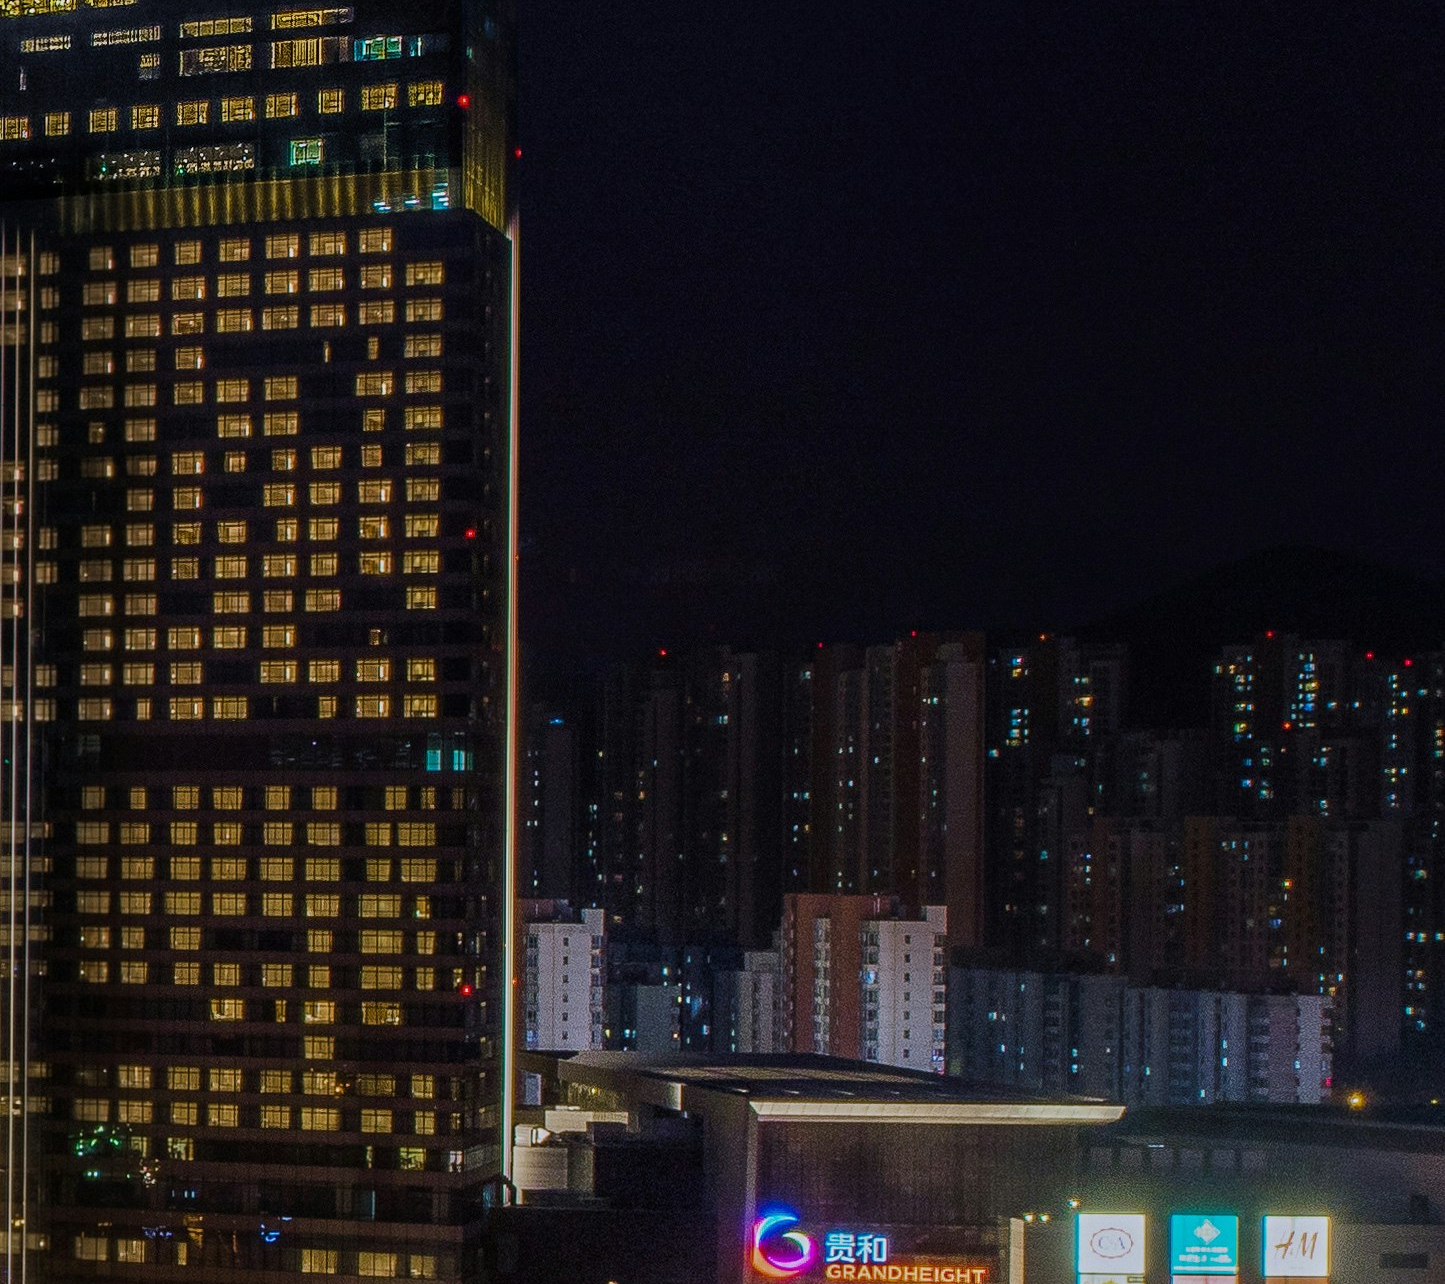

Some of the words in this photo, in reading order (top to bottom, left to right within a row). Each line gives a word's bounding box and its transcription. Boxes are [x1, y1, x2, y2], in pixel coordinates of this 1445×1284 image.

[825, 1233, 887, 1264] 贵和
[1273, 1230, 1319, 1260] H&M
[825, 1264, 987, 1284] GRANDHEIGHT
